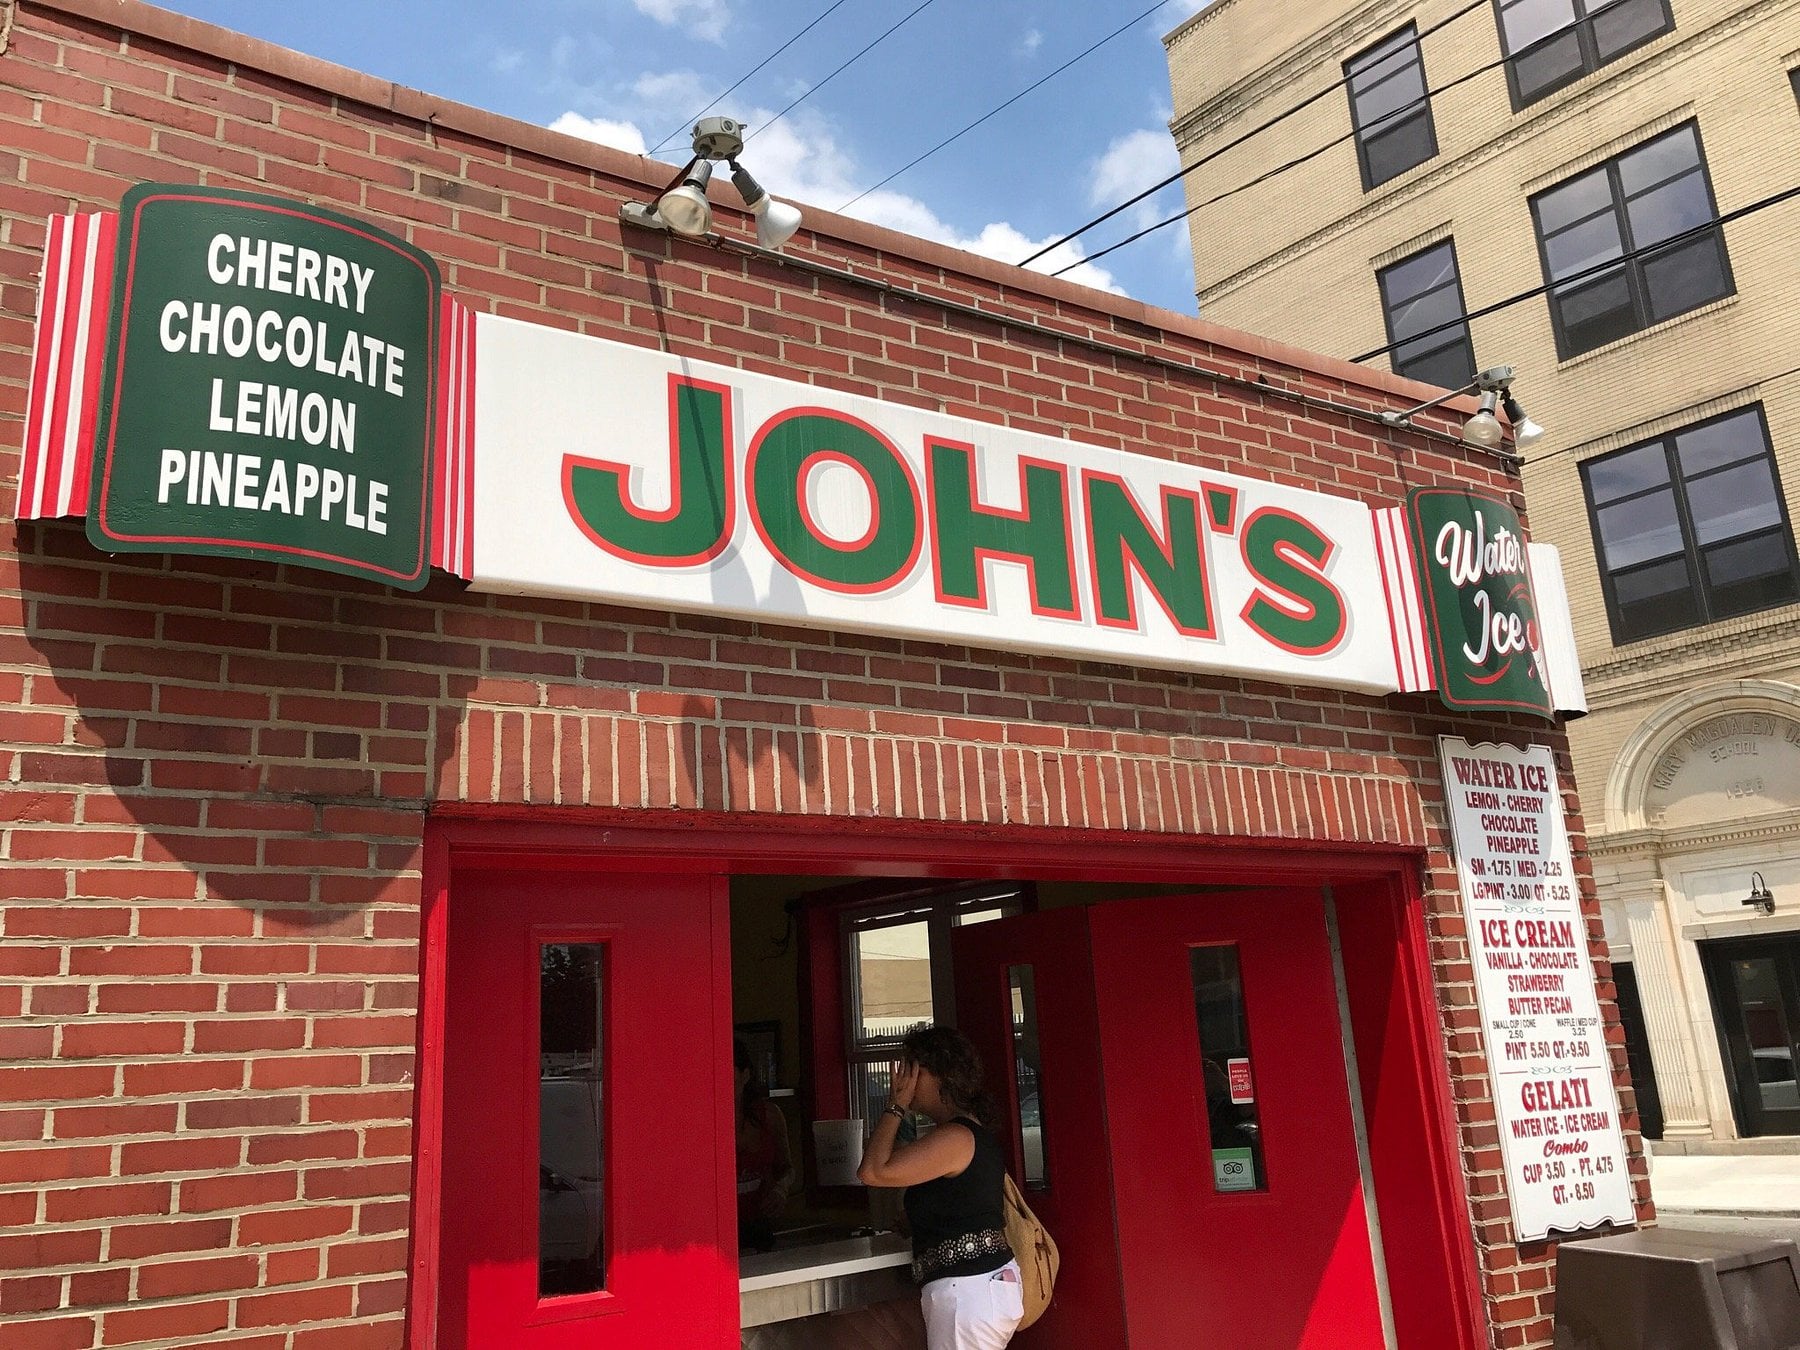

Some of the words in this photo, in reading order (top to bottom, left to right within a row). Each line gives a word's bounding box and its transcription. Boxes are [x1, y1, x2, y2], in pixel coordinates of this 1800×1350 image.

[207, 233, 375, 314] CHERRY
[159, 300, 405, 397] CHOCOLATE
[208, 378, 356, 453] LEMON
[157, 449, 389, 536] PINEAPPLE
[561, 373, 1347, 657] JOHN'S
[1435, 510, 1525, 587] Water
[1463, 590, 1526, 665] Ice
[1709, 740, 1760, 763] SCHOOL
[1452, 757, 1517, 789] WATER
[1518, 764, 1549, 793] ICE
[1653, 749, 1685, 790] MARY
[1465, 791, 1499, 810] LEMON
[1505, 795, 1544, 814] CHERRY
[1481, 814, 1539, 835] CHOCOLATE
[1487, 835, 1540, 855] PINEAPPLE
[1471, 857, 1486, 875] SM
[1491, 860, 1512, 876] 1.75
[1517, 860, 1537, 878] MED
[1543, 861, 1563, 876] 2.25
[1511, 883, 1531, 900] 3.00
[1534, 884, 1545, 901] QT
[1551, 885, 1571, 900] 5.25
[1479, 919, 1511, 948] ICE
[1514, 920, 1576, 949] CREAM
[1485, 951, 1524, 970] VANILLA
[1529, 951, 1579, 970] CHOCOLATE
[1507, 974, 1564, 992] STRAWBERRY
[1507, 997, 1543, 1015] BUTTER
[1543, 996, 1573, 1014] PECAN
[1492, 1020, 1509, 1030] SMALL
[1508, 1030, 1524, 1039] 2.50
[1572, 1027, 1587, 1036] 3.25
[1505, 1041, 1528, 1061] PINT
[1530, 1041, 1551, 1059] 5.50
[1521, 1078, 1592, 1113] GELATI
[1511, 1118, 1543, 1139] WATER
[1544, 1116, 1560, 1136] ICE
[1565, 1114, 1580, 1134] ICE
[1580, 1111, 1610, 1132] CREAM
[1543, 1138, 1589, 1158] Combo
[1523, 1163, 1543, 1184] CUP
[1545, 1160, 1566, 1181] 3.50
[1596, 1155, 1613, 1175] 4.75
[1575, 1181, 1595, 1201] 8.50
